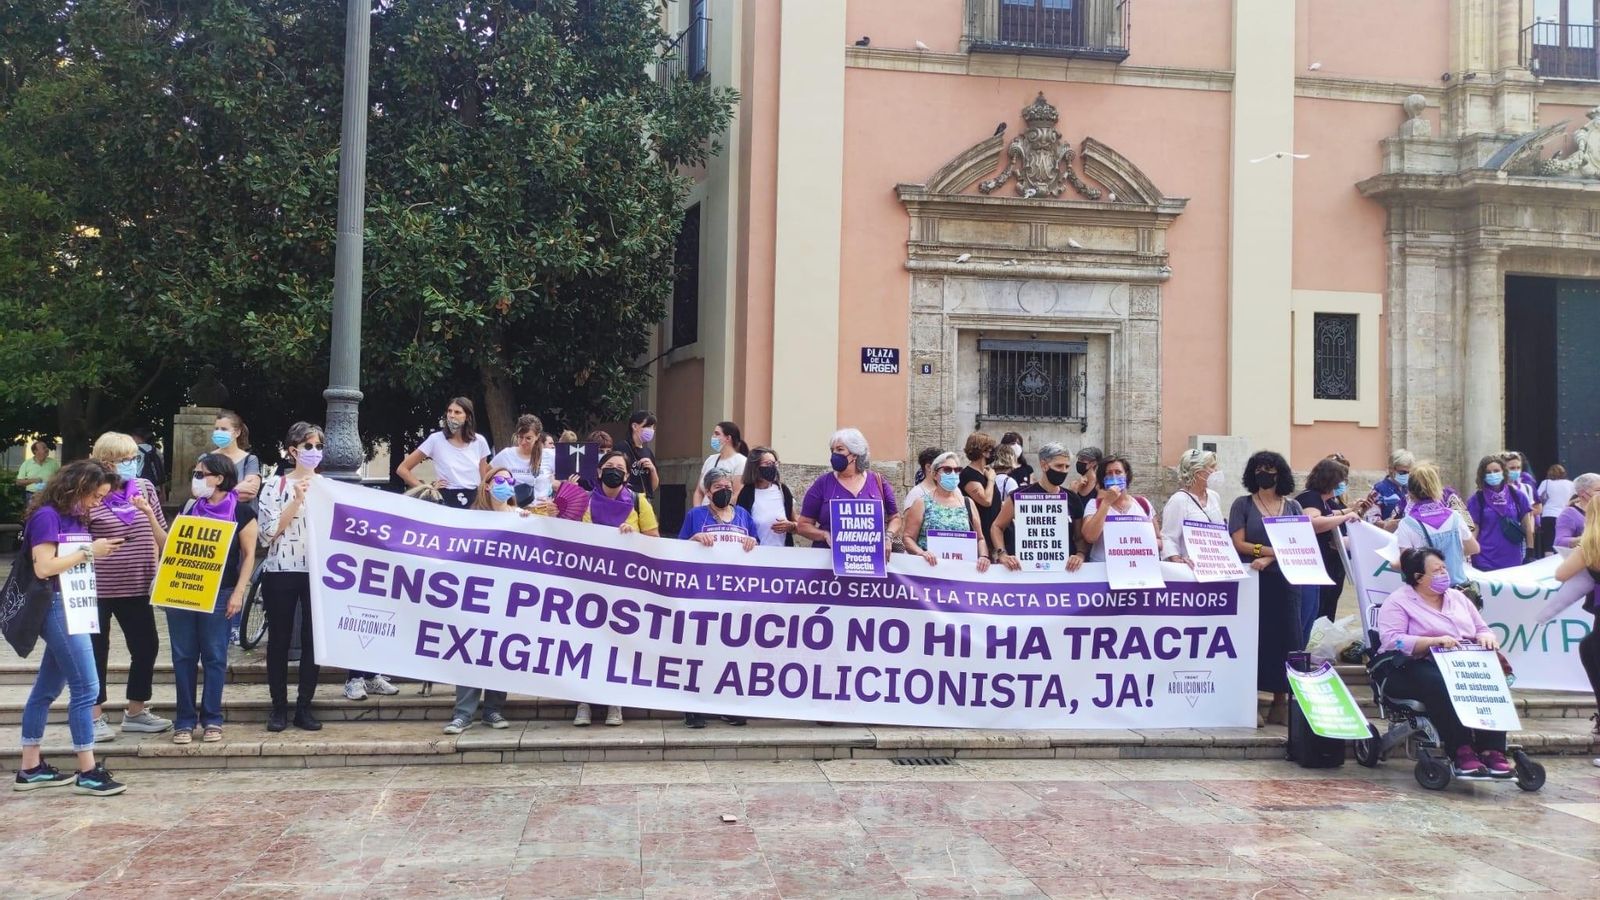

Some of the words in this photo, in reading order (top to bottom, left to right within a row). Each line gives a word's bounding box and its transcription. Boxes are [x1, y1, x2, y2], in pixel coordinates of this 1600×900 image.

[867, 348, 894, 358] PLAZA
[863, 363, 898, 373] VIRGEN
[924, 365, 929, 373] 6
[839, 503, 852, 515] LA
[855, 503, 874, 515] LLEI
[1020, 504, 1029, 513] NI
[1031, 504, 1043, 513] UN
[1046, 504, 1063, 514] PAS
[840, 517, 875, 530] TRANS
[1026, 516, 1056, 525] ENRERE
[178, 525, 194, 539] LA
[197, 526, 222, 543] LLEI
[836, 531, 881, 544] AMENAÇA
[1028, 528, 1038, 537] EN
[1041, 528, 1055, 537] ELS
[1022, 540, 1048, 549] DRETS
[1052, 540, 1062, 549] DE
[1119, 536, 1128, 544] LA
[1129, 536, 1142, 544] PNL
[1288, 536, 1297, 544] LA
[175, 541, 217, 559] TRANS
[840, 544, 876, 553] qualsevol
[846, 553, 871, 562] Procés
[942, 552, 950, 560] LA
[1020, 552, 1034, 561] LES
[1037, 552, 1065, 561] DONES
[163, 556, 177, 566] NO
[176, 558, 223, 572] PERSEGUEIX
[344, 517, 392, 541] 23-S
[402, 530, 440, 550] DIA
[446, 537, 618, 577] INTERNACIONAL
[624, 563, 700, 590] CONTRA
[848, 582, 919, 601] SEXUAL
[924, 588, 932, 602] I
[937, 589, 960, 605] LA
[965, 591, 1041, 608] TRACTA
[1046, 593, 1072, 608] DE
[1077, 592, 1137, 608] DONES
[1142, 592, 1151, 607] I
[1155, 592, 1229, 607] MENORS
[844, 561, 874, 570] Selectiu
[175, 570, 203, 582] Igualtat
[70, 579, 86, 591] NO
[169, 580, 179, 589] de
[181, 581, 204, 592] Tracte
[322, 553, 495, 614] SENSE
[505, 582, 834, 651] PROSTITUCIÓ
[846, 617, 910, 654] NO
[923, 621, 971, 658] HI
[986, 625, 1052, 660] HA
[1063, 626, 1238, 661] TRACTA
[337, 615, 396, 638] ABOLICIONISTA
[415, 619, 593, 680] EXIGIM
[606, 646, 703, 693] LLEI
[713, 661, 1079, 714] ABOLICIONISTA,
[1092, 673, 1155, 708] JA!
[1452, 660, 1466, 668] Llei
[1468, 660, 1480, 668] per
[1167, 681, 1216, 694] ABOLICIONISTA
[1455, 683, 1468, 691] del
[1469, 684, 1500, 692] sistema
